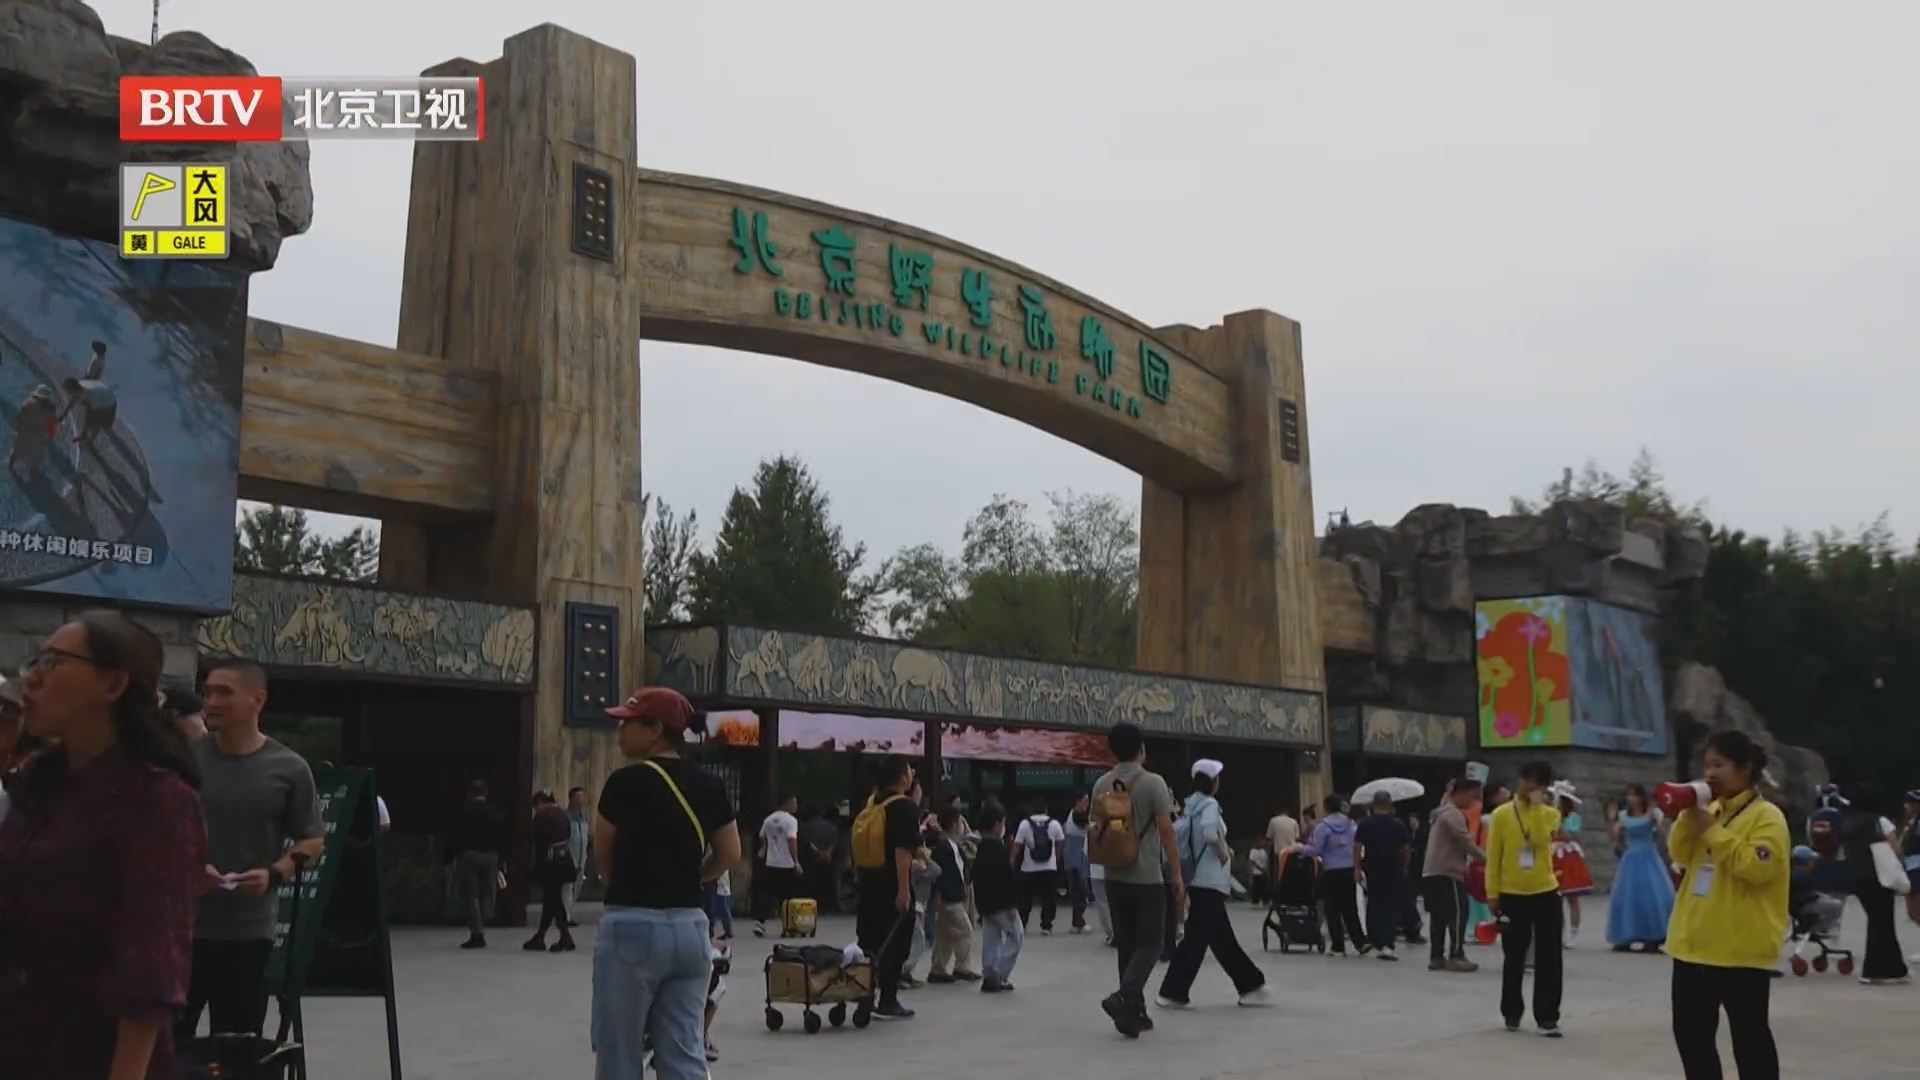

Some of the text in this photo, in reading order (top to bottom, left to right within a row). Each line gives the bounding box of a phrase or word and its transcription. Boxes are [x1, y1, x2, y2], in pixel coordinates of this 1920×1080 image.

[730, 206, 1171, 405] 北京野生动物园
[774, 288, 1144, 418] BEIJING WILDLIFE PARK
[0, 529, 153, 565] 种休闲娱乐项目
